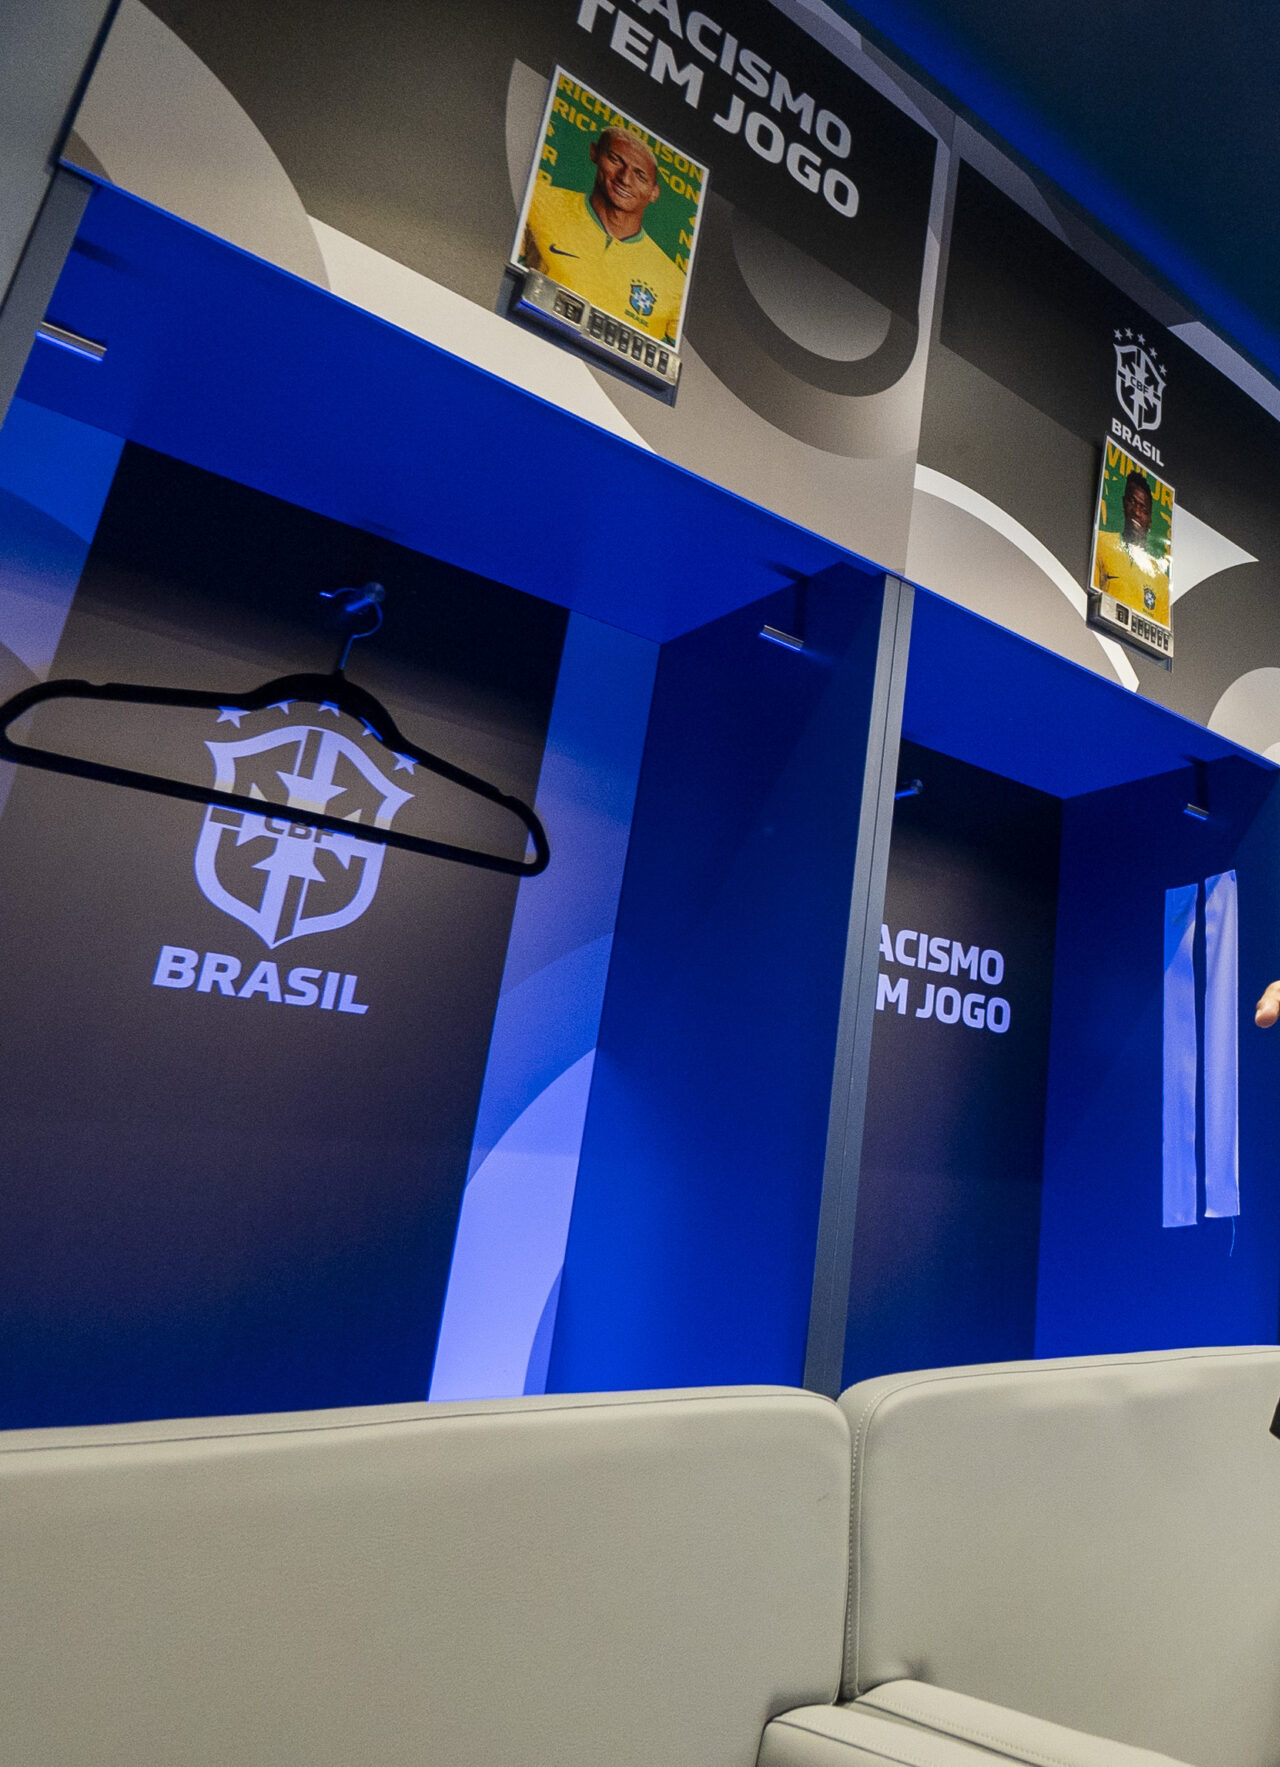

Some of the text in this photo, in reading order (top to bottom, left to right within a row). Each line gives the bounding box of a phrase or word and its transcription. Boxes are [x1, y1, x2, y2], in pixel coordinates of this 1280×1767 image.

[577, 0, 859, 217] TEM JOGO
[632, 0, 851, 158] ACISMO
[1112, 417, 1164, 467] BRASIL
[152, 945, 369, 1015] BRASIL
[879, 923, 1005, 986] ACISMO
[915, 983, 1011, 1034] JOGO
